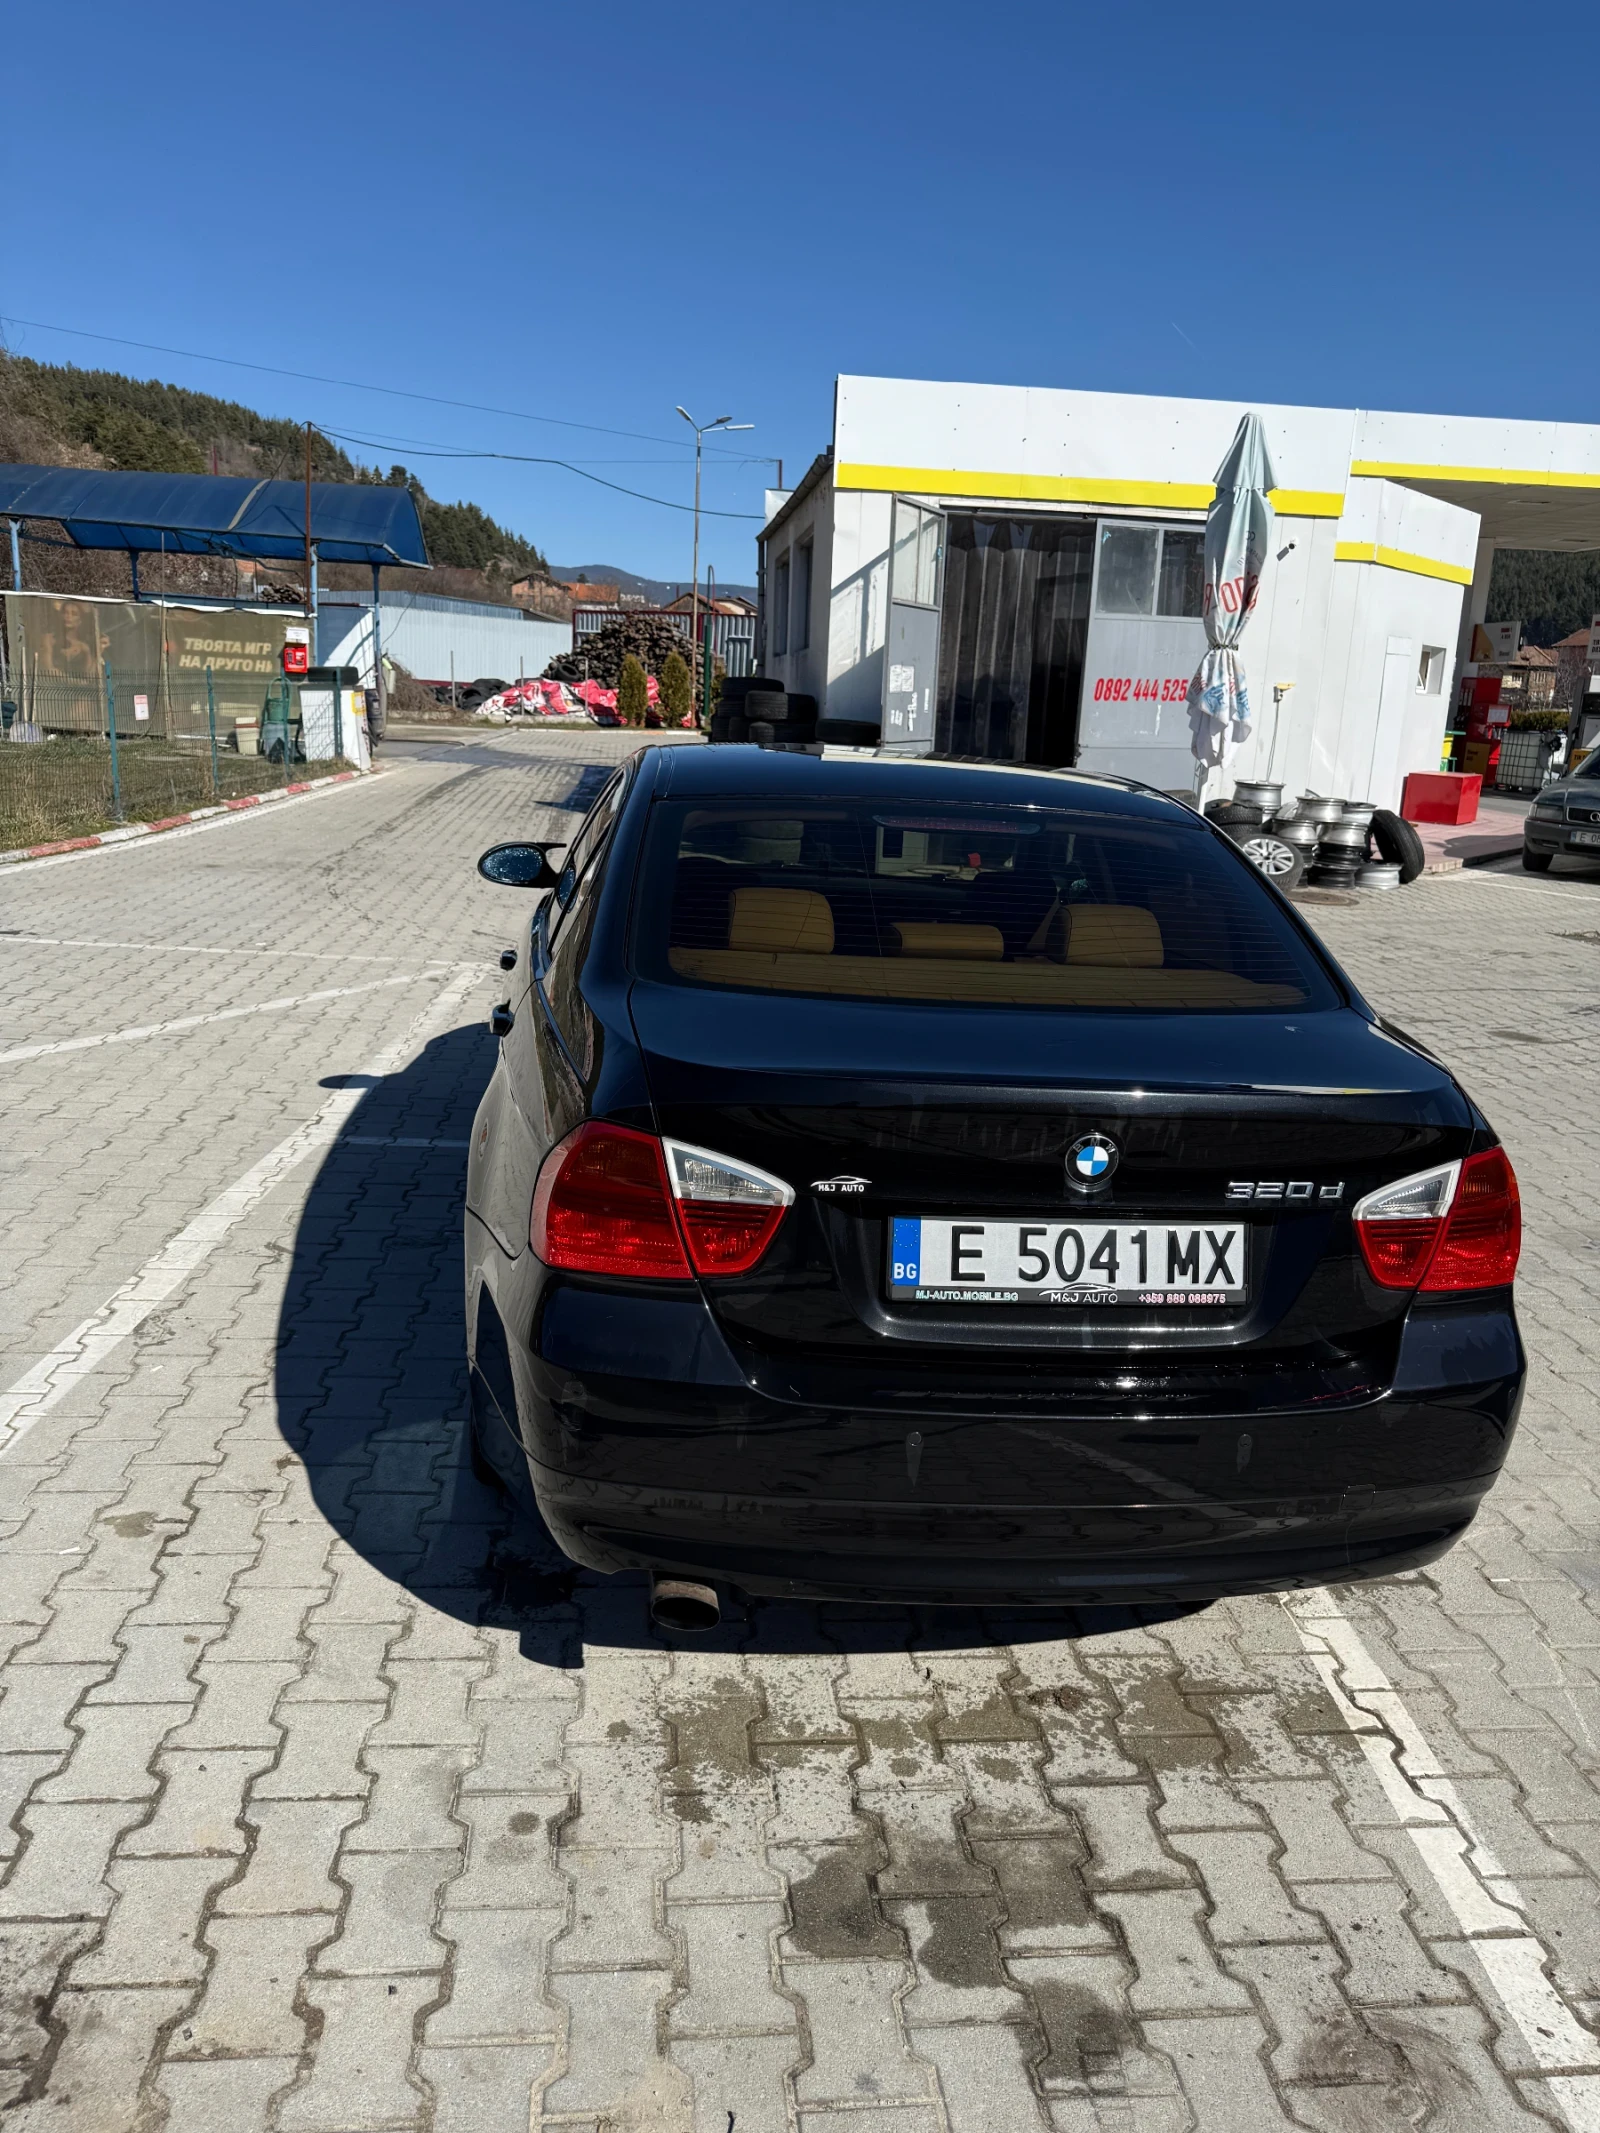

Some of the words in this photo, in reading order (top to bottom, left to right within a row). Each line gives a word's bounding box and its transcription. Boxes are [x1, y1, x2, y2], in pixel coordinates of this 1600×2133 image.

[184, 637, 242, 653] ТВОЯТА
[179, 654, 201, 668] НА
[203, 656, 254, 673] ДРУГО
[1093, 677, 1132, 702] 0892
[1133, 678, 1160, 702] 444
[1161, 678, 1188, 702] 525
[1579, 832, 1587, 843] E
[1072, 1137, 1116, 1154] BMW
[818, 1184, 836, 1192] M&J
[840, 1184, 865, 1192] AUTO
[950, 1226, 986, 1282] E
[893, 1262, 918, 1279] BG
[914, 1289, 1019, 1302] MJ-AUTO.MOBILE.BG
[1050, 1291, 1080, 1303] M&J
[1082, 1292, 1118, 1304] AUTO
[1138, 1293, 1164, 1304] +359
